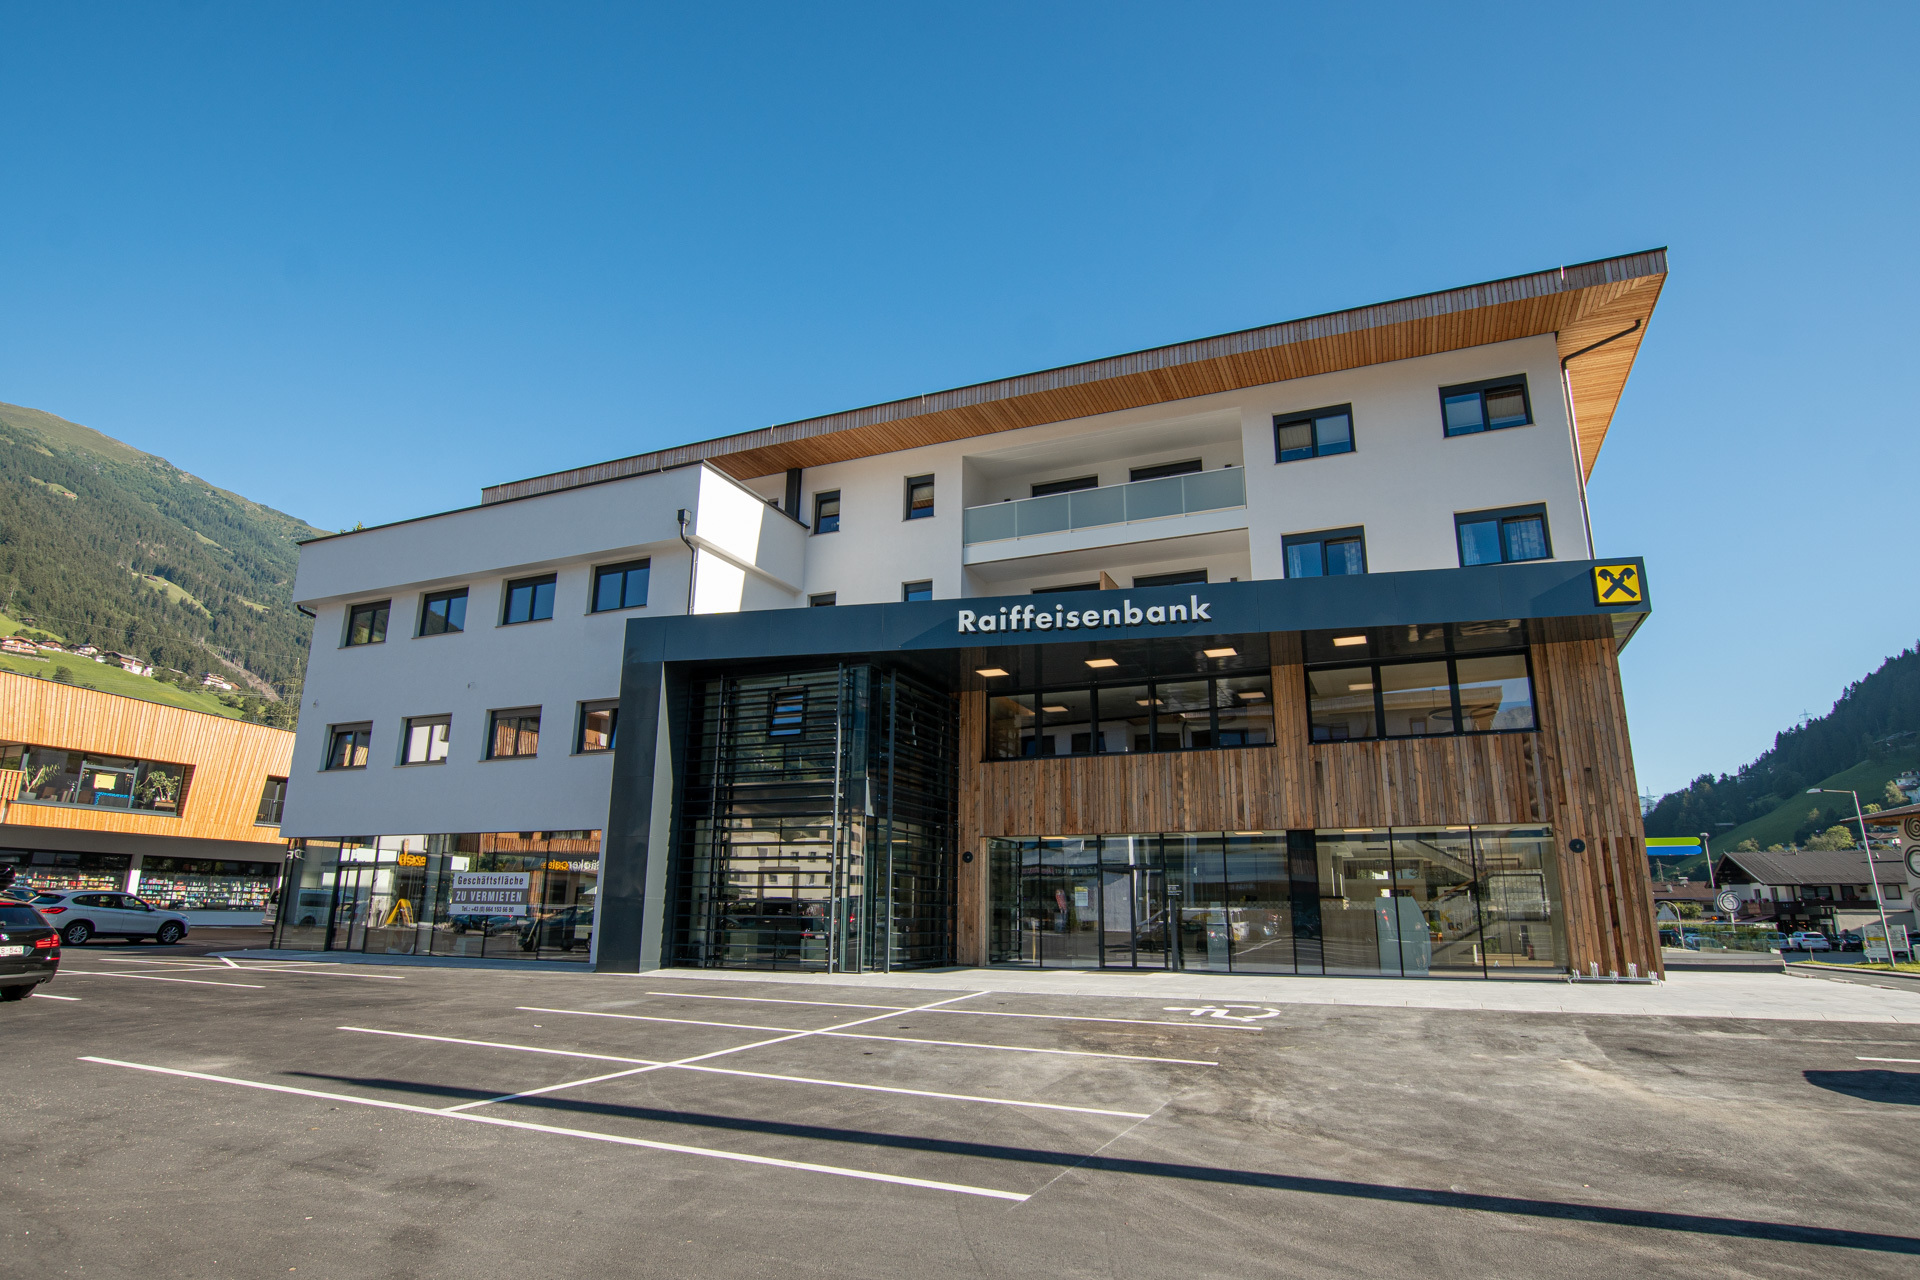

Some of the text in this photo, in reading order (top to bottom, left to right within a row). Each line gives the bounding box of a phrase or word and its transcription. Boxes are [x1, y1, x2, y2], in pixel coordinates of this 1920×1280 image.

[958, 595, 1212, 634] Raiffeisenbank
[457, 876, 524, 885] Geschäftsfläche
[455, 891, 523, 901] ZU VERMIETEN
